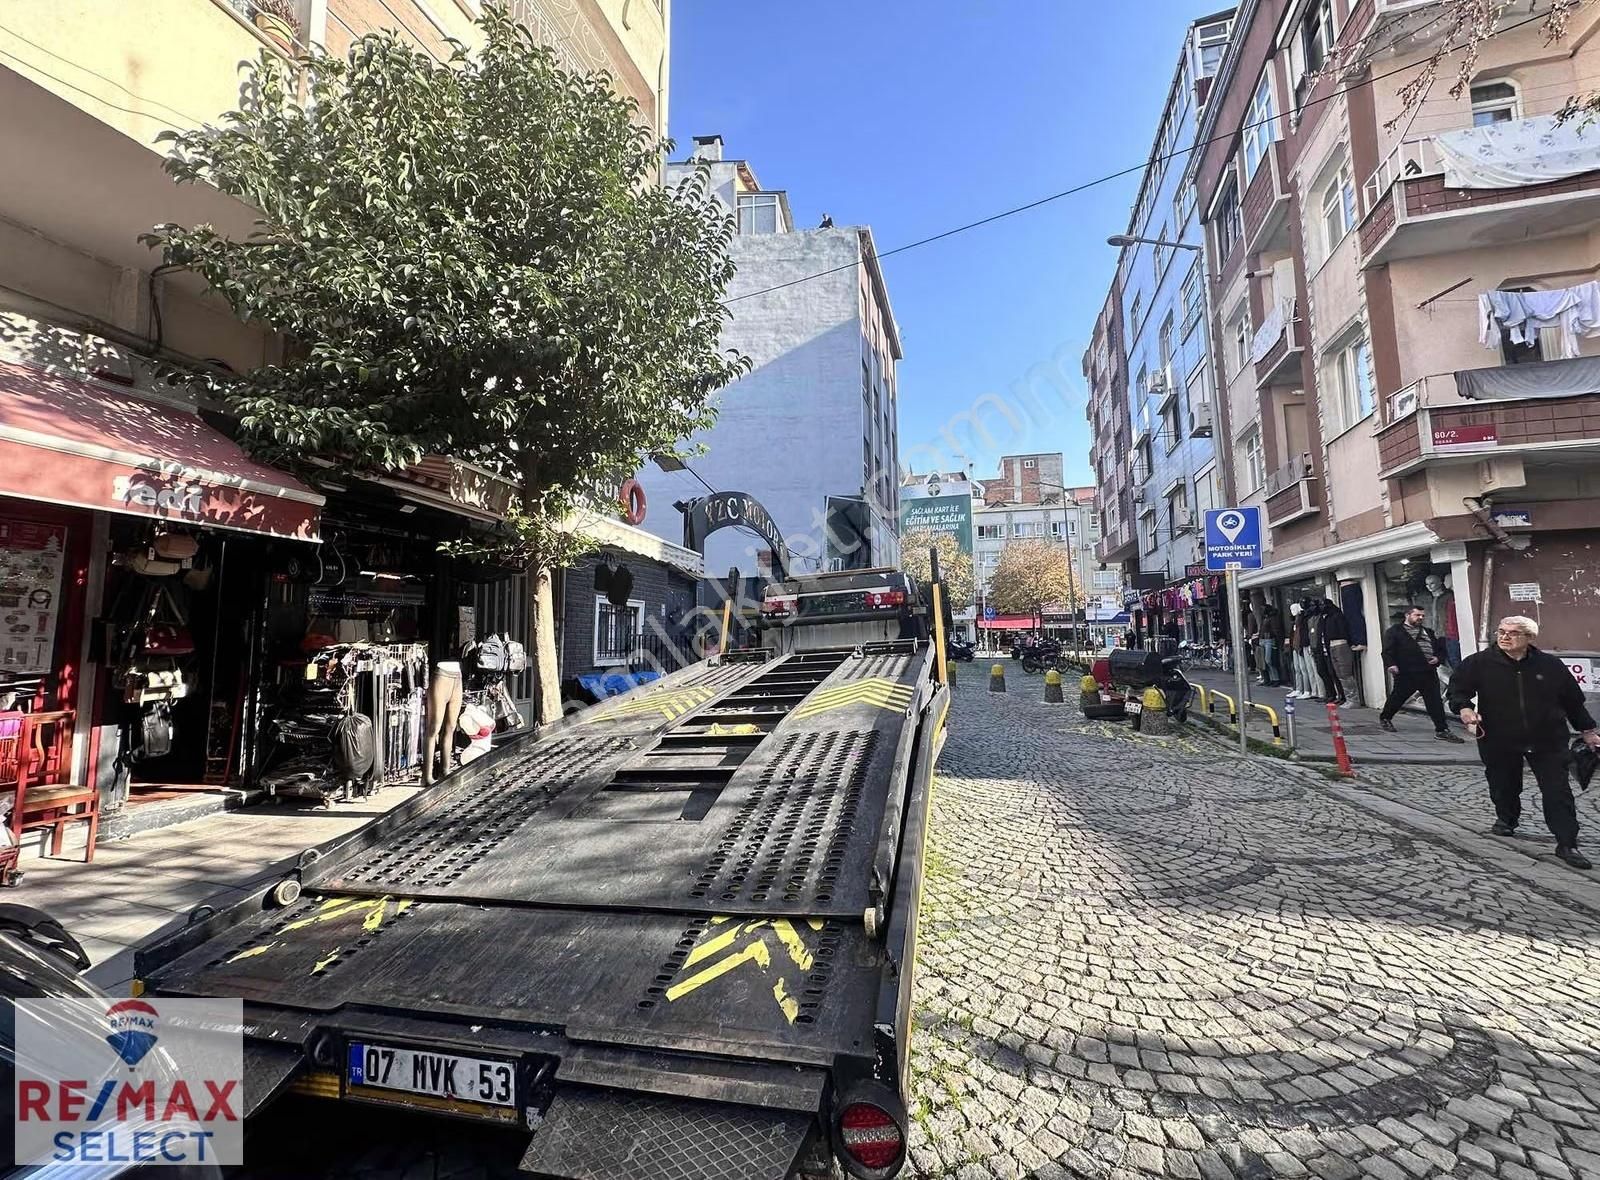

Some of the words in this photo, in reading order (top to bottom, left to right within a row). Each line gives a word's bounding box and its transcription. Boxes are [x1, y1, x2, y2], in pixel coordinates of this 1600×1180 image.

[905, 515, 930, 526] EĞİTİM
[931, 516, 940, 524] VE
[940, 513, 966, 523] SAĞLIK
[352, 1066, 363, 1076] TR
[366, 1049, 395, 1084] 07
[412, 1054, 458, 1095] MVK
[479, 1064, 511, 1102] 53
